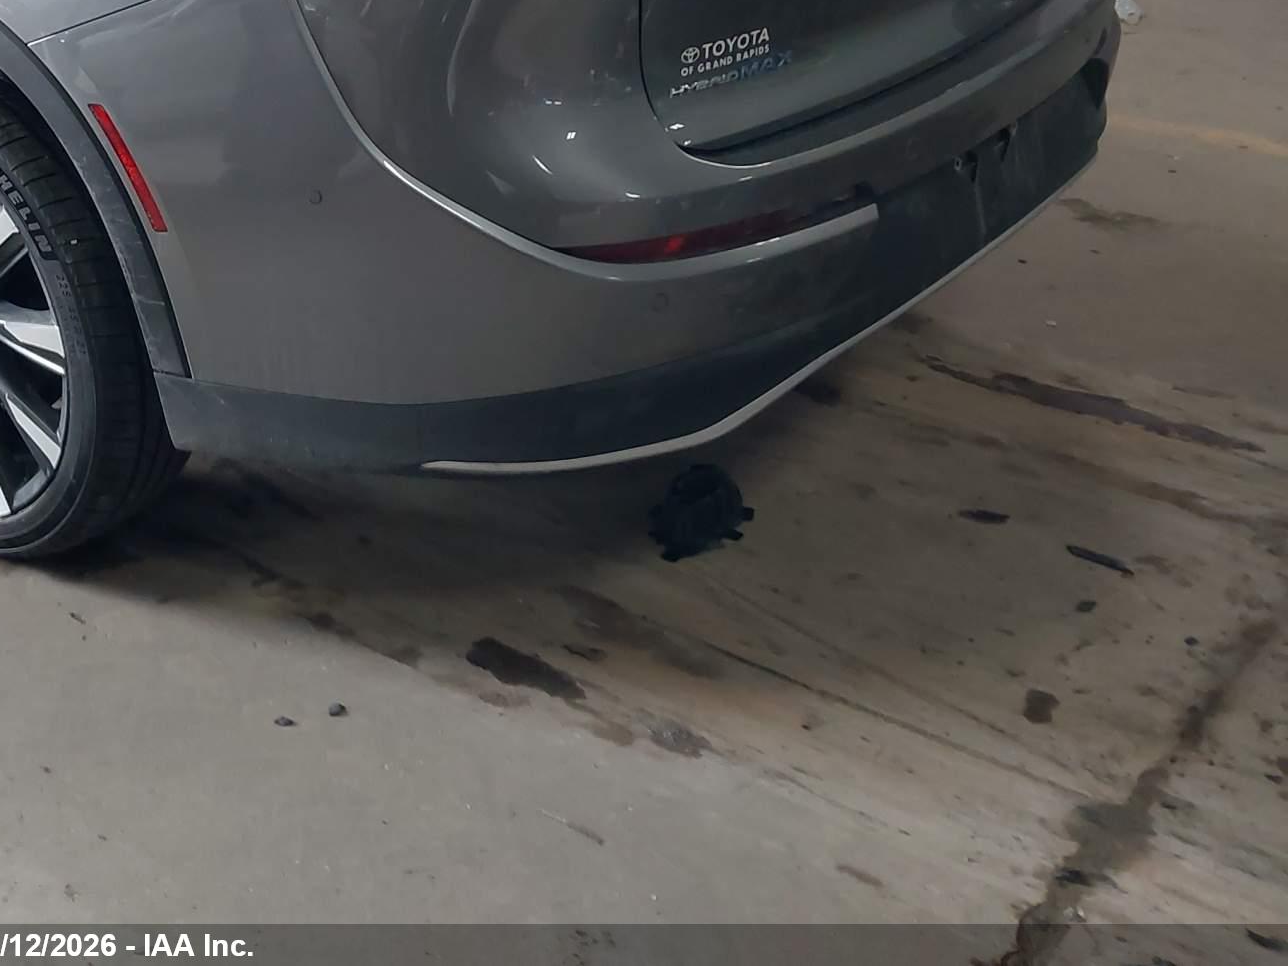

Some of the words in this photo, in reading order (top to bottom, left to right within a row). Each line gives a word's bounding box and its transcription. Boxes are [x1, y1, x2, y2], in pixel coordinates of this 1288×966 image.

[702, 27, 770, 59] TOYOTA
[680, 65, 694, 77] OF
[697, 55, 733, 74] GRAND
[736, 43, 770, 62] RAPIDS
